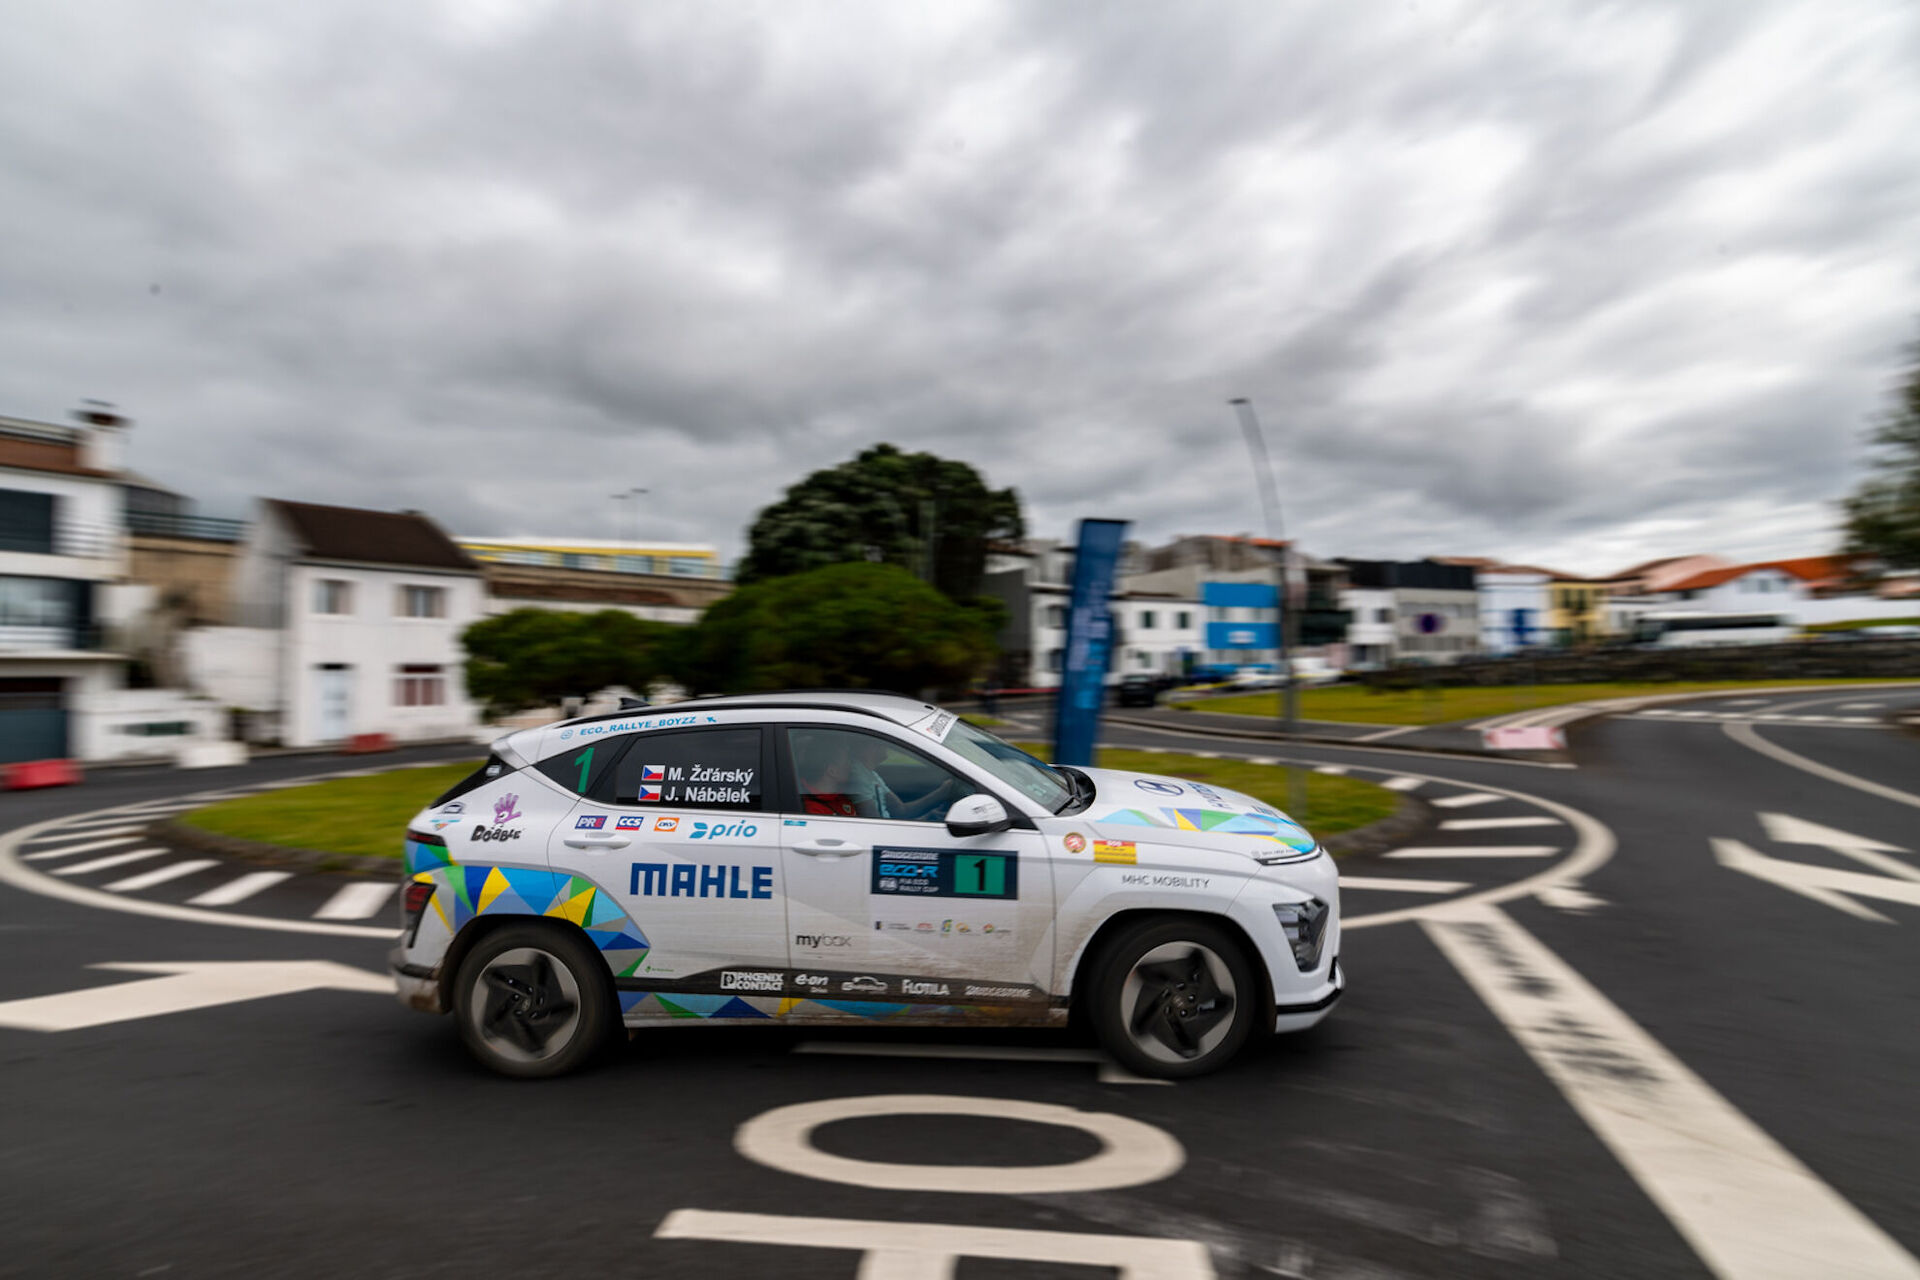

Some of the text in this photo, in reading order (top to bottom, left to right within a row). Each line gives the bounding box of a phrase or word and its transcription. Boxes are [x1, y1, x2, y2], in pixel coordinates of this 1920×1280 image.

[574, 747, 595, 793] 1
[667, 764, 754, 786] M. Žďárský
[665, 786, 751, 803] J. Nábělek
[619, 817, 642, 827] CCS
[708, 820, 758, 839] prio
[630, 863, 773, 899] MAHLE
[974, 859, 986, 891] 1
[1122, 874, 1210, 888] MHC MOBILITY
[737, 981, 784, 991] CONTACT
